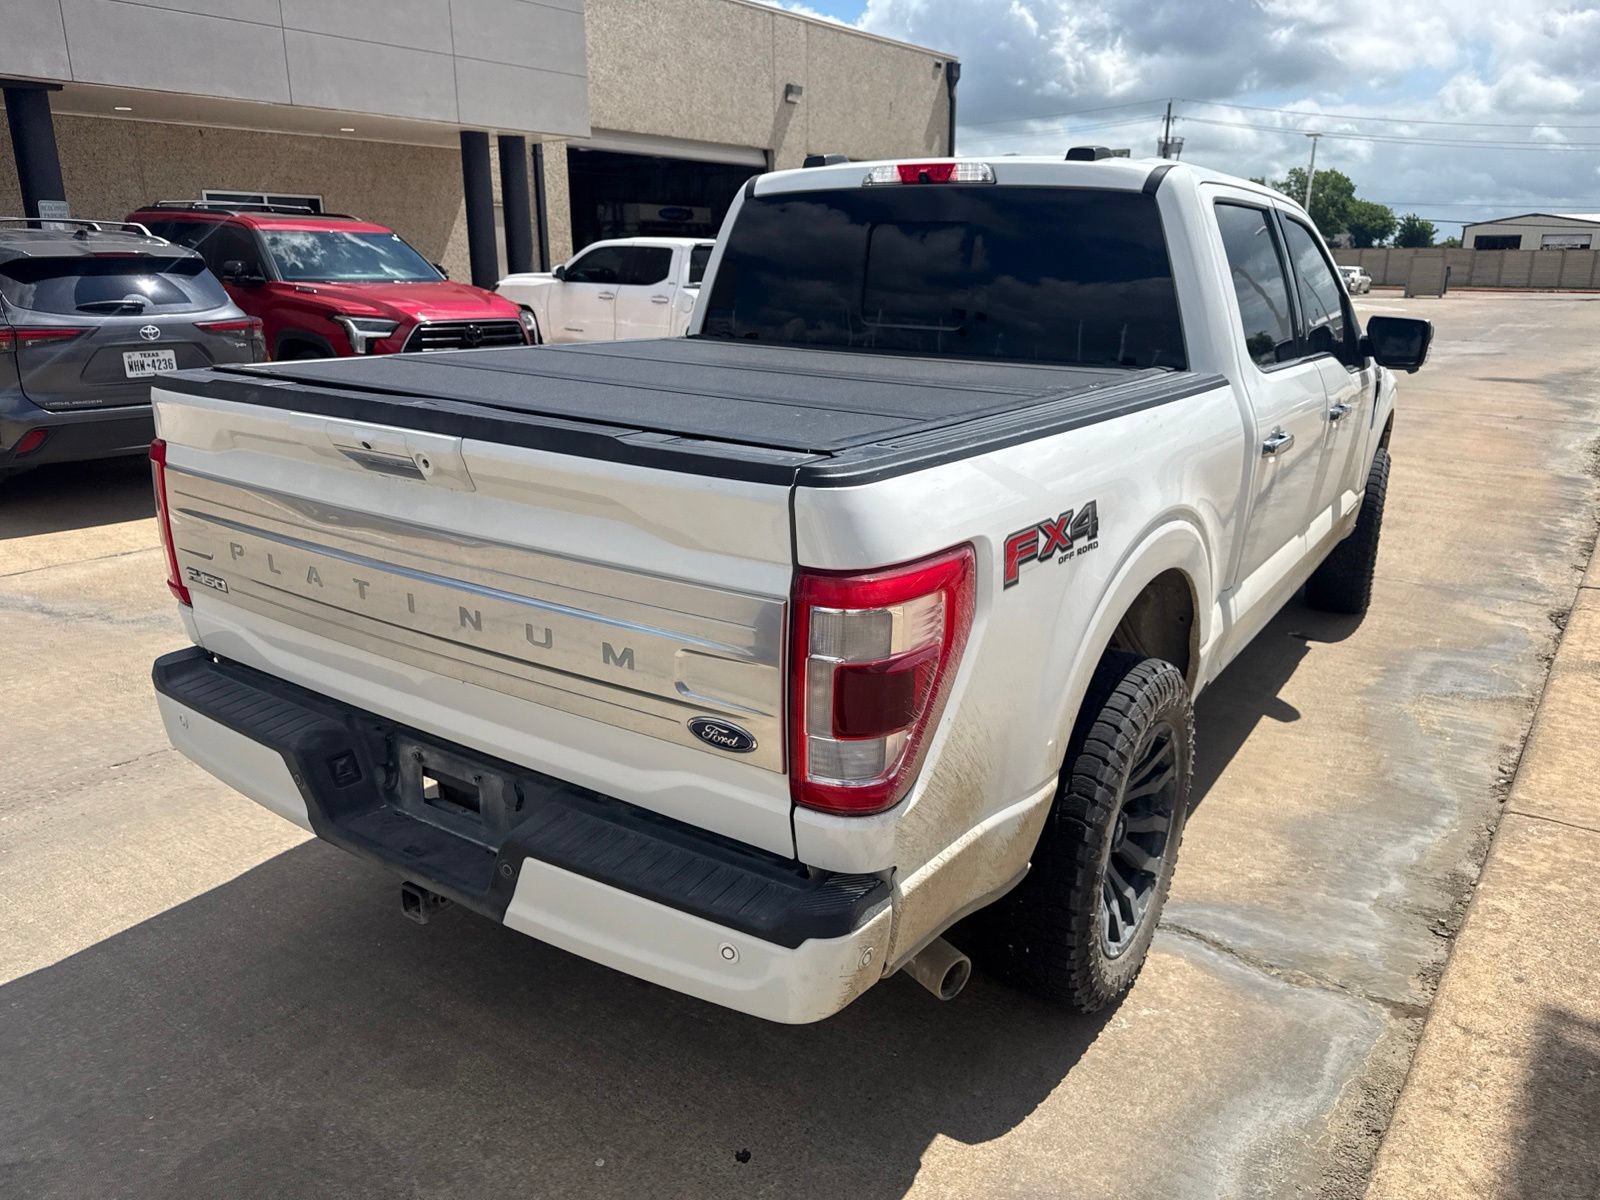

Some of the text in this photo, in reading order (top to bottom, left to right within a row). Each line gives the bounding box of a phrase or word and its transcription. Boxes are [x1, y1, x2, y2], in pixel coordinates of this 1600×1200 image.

[1003, 499, 1099, 591] FX4
[1058, 541, 1099, 565] OFF ROAD
[229, 542, 635, 671] PLATINUM
[702, 724, 739, 747] Ford
